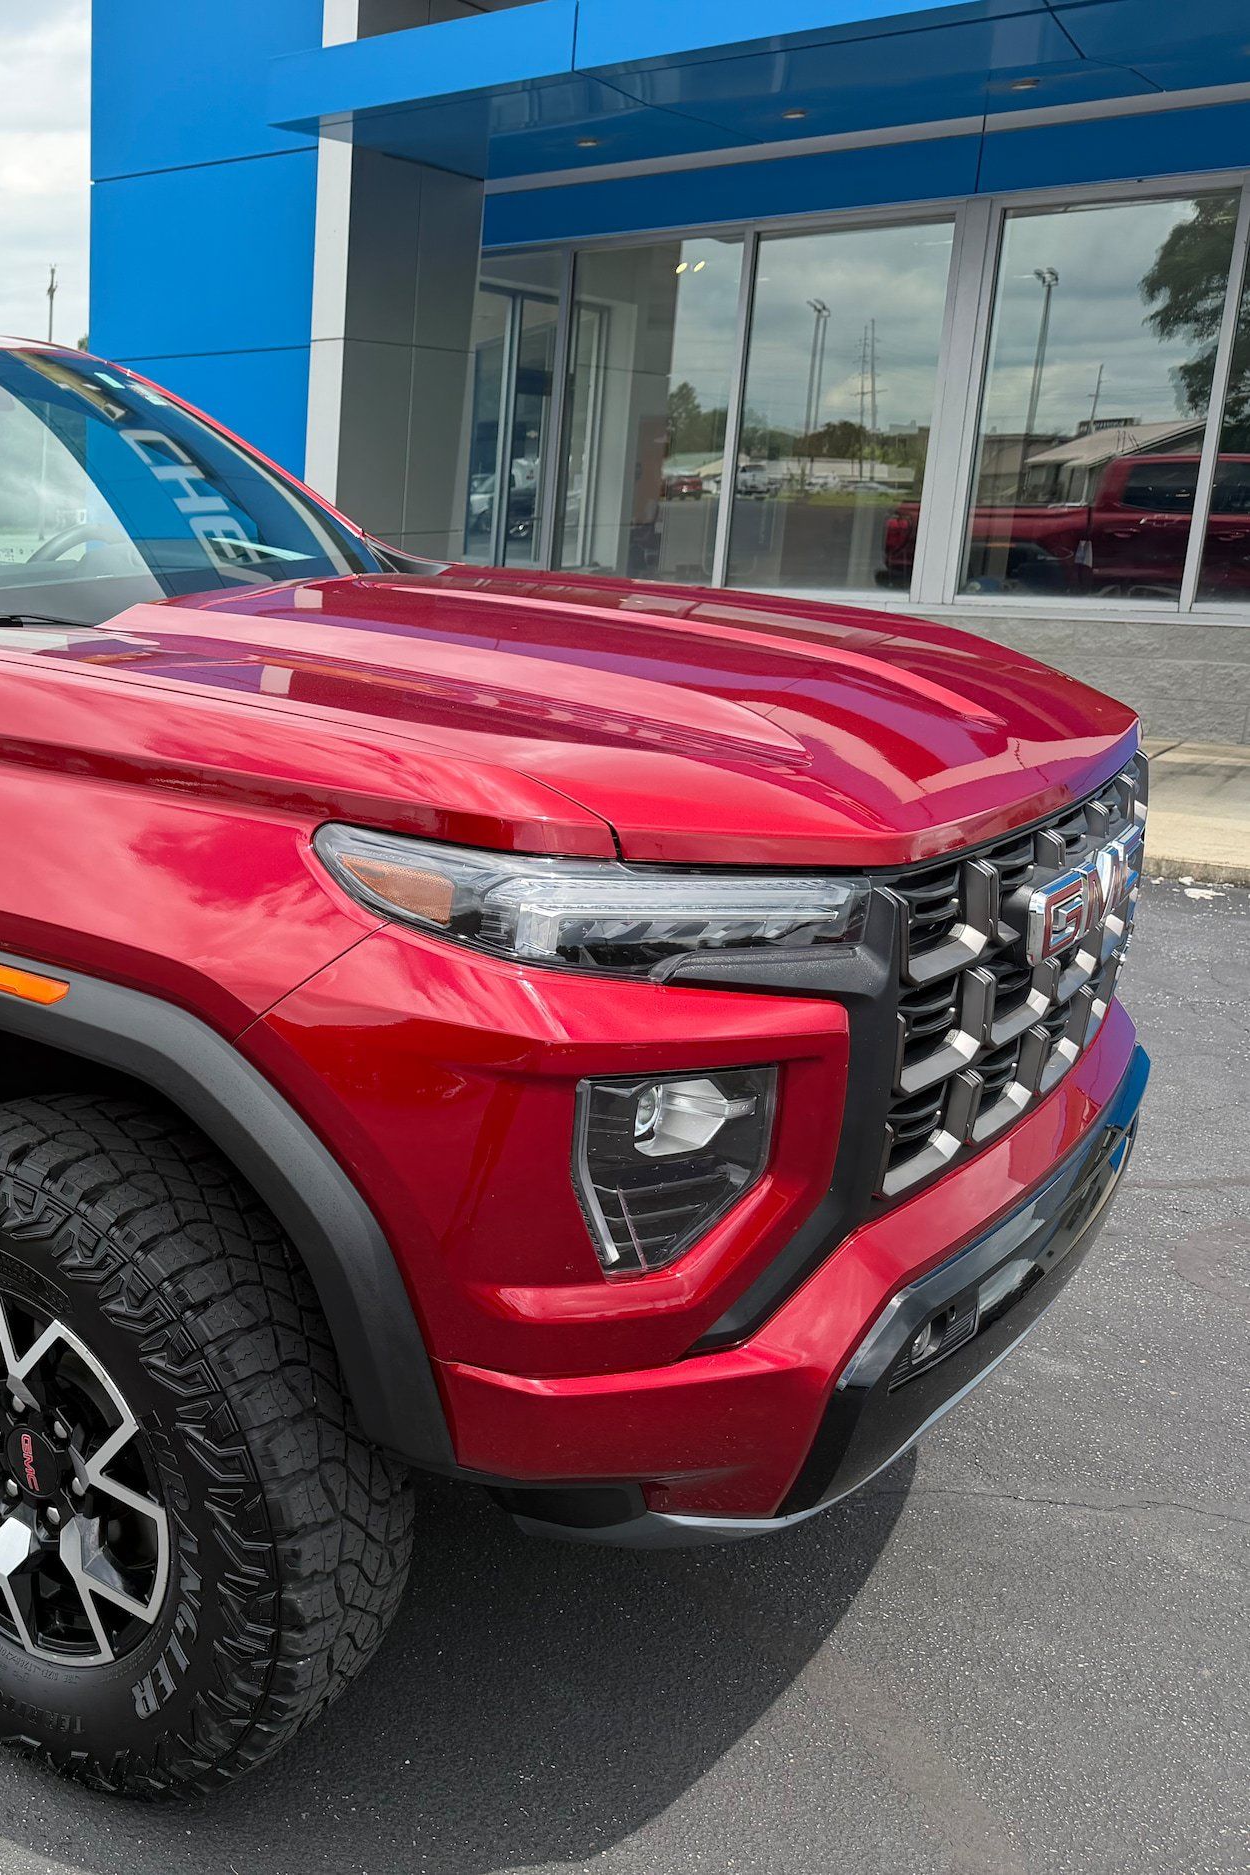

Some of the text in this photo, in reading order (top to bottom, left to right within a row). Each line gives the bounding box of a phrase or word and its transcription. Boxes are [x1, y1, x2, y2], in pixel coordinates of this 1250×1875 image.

[1027, 823, 1146, 967] GMC
[21, 1433, 40, 1492] GMC
[132, 1409, 203, 1720] WRANGLER
